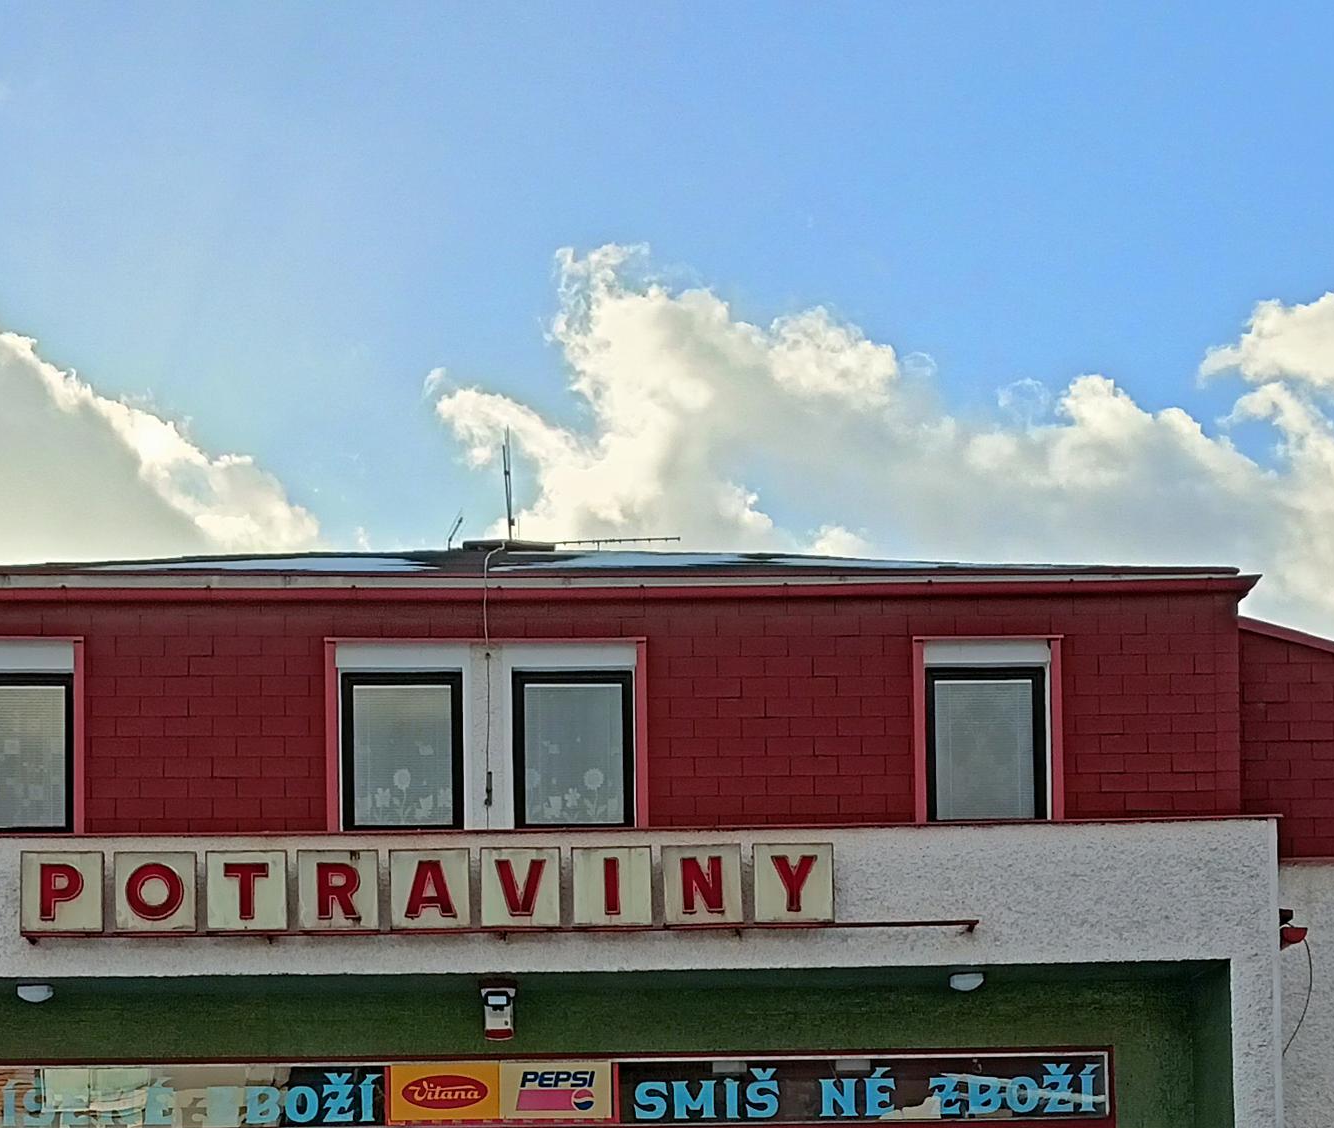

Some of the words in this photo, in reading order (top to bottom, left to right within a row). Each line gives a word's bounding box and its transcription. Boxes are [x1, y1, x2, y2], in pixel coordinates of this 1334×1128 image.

[40, 854, 819, 922] POTRAVINY
[409, 1080, 482, 1101] Vitana
[520, 1071, 595, 1088] PEPSI
[928, 1063, 1100, 1115] ZBOŽÍ
